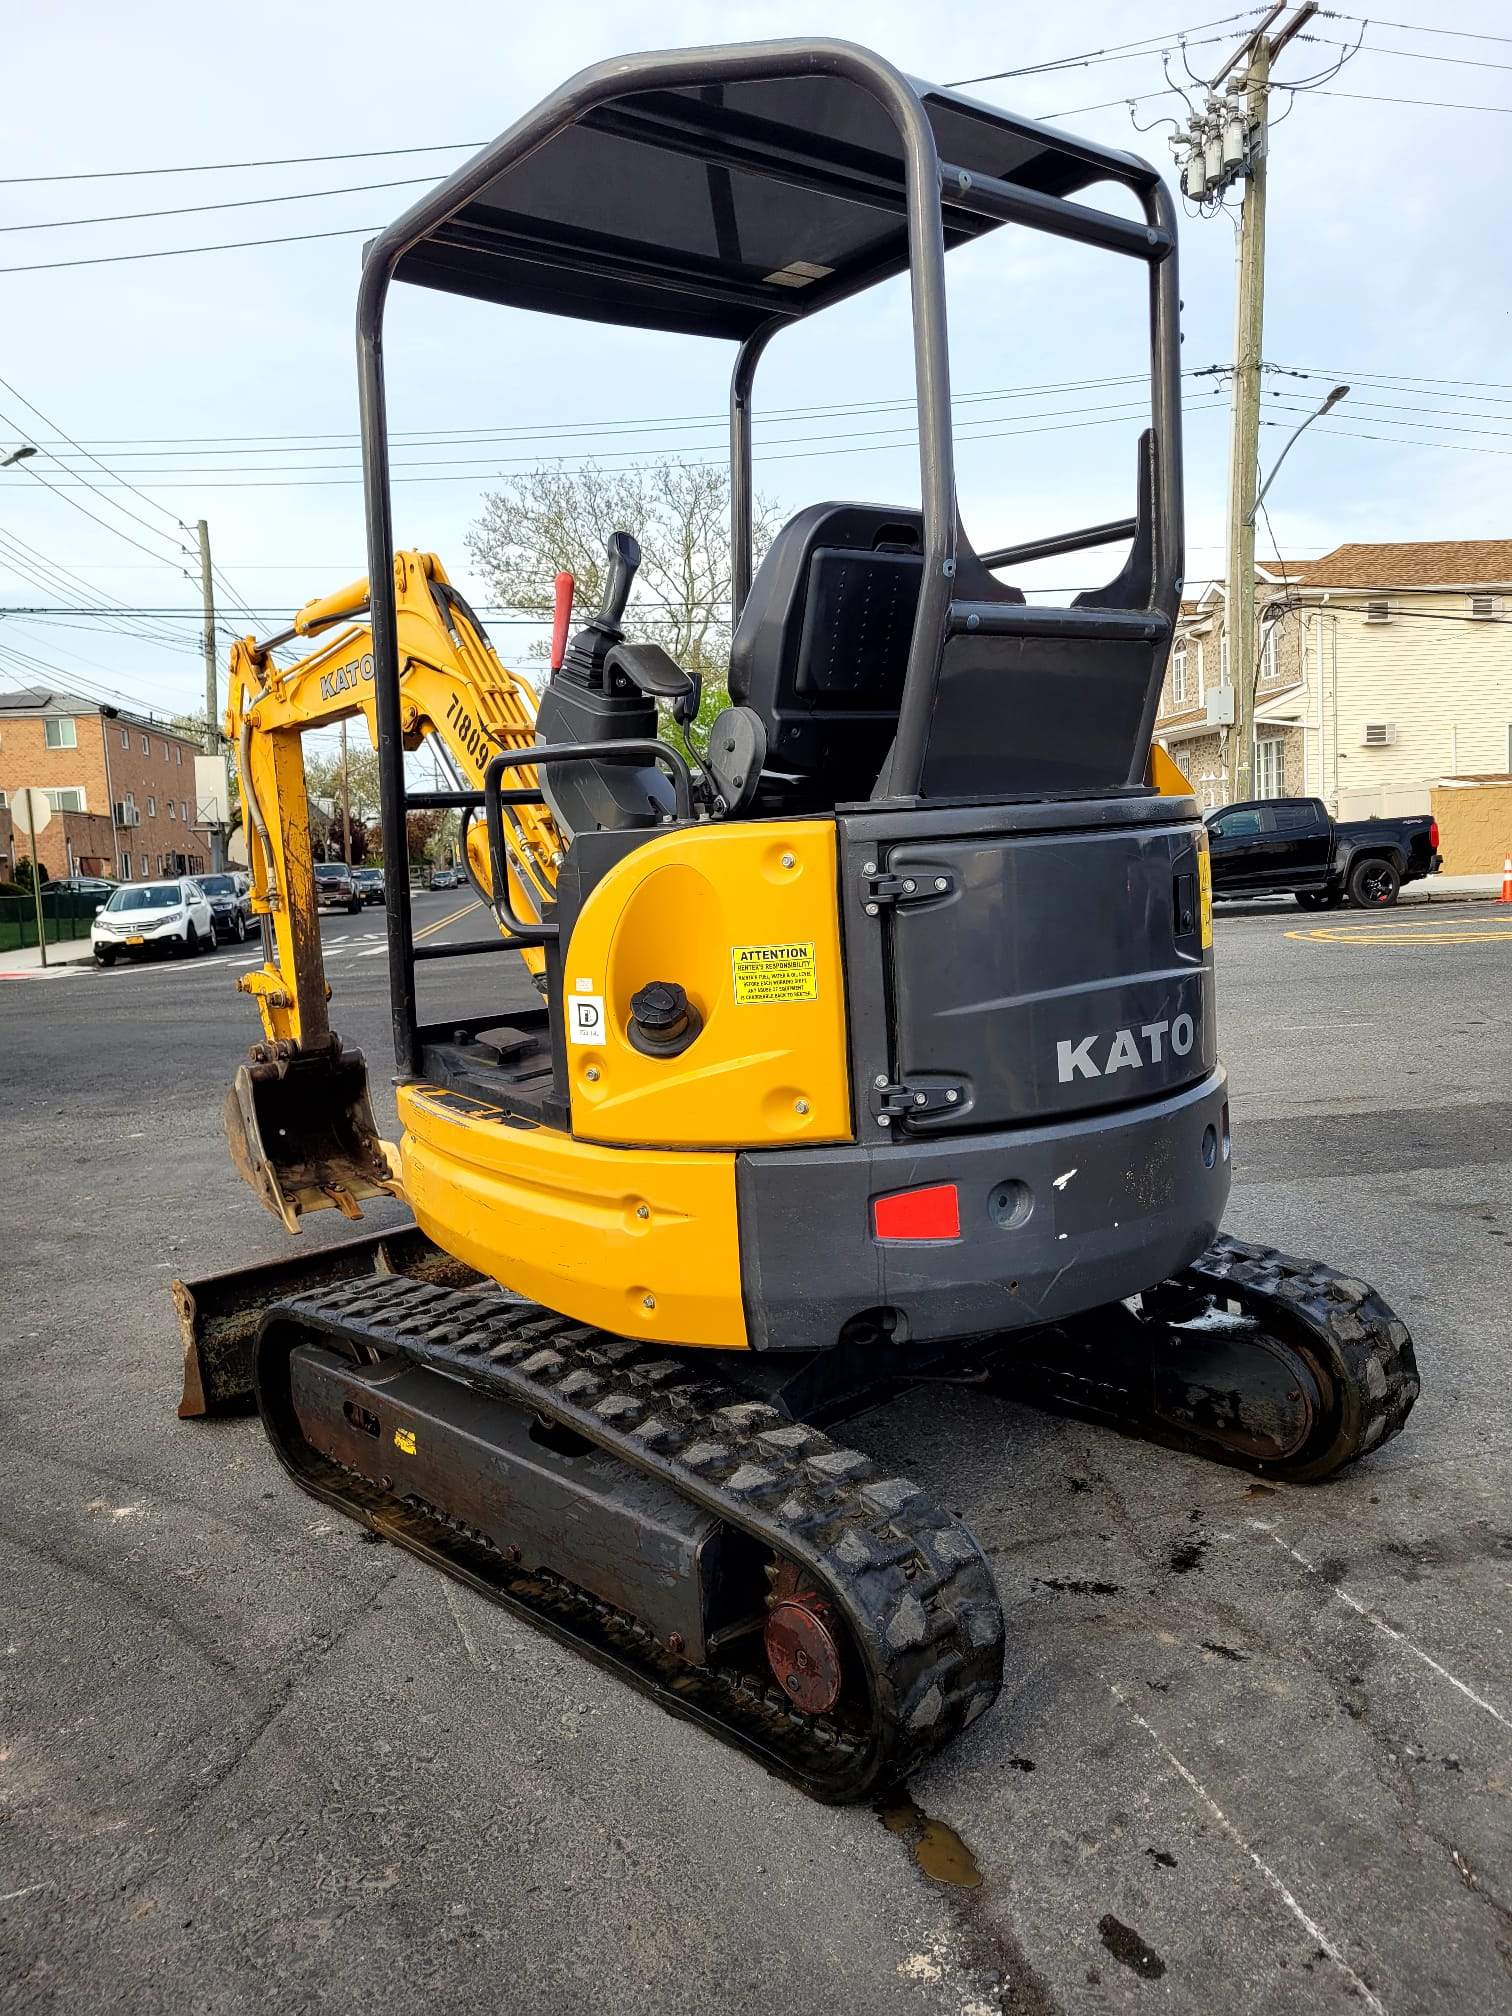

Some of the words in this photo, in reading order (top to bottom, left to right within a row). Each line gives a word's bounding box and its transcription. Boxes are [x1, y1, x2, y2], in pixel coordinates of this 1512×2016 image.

[319, 653, 376, 701] KATO
[447, 692, 495, 772] 71809
[737, 964, 763, 972] RENTER'S
[765, 961, 811, 970] RESPONSIBILITY
[740, 948, 808, 961] ATTENTION
[577, 1003, 599, 1028] D
[1056, 1013, 1194, 1083] KATO
